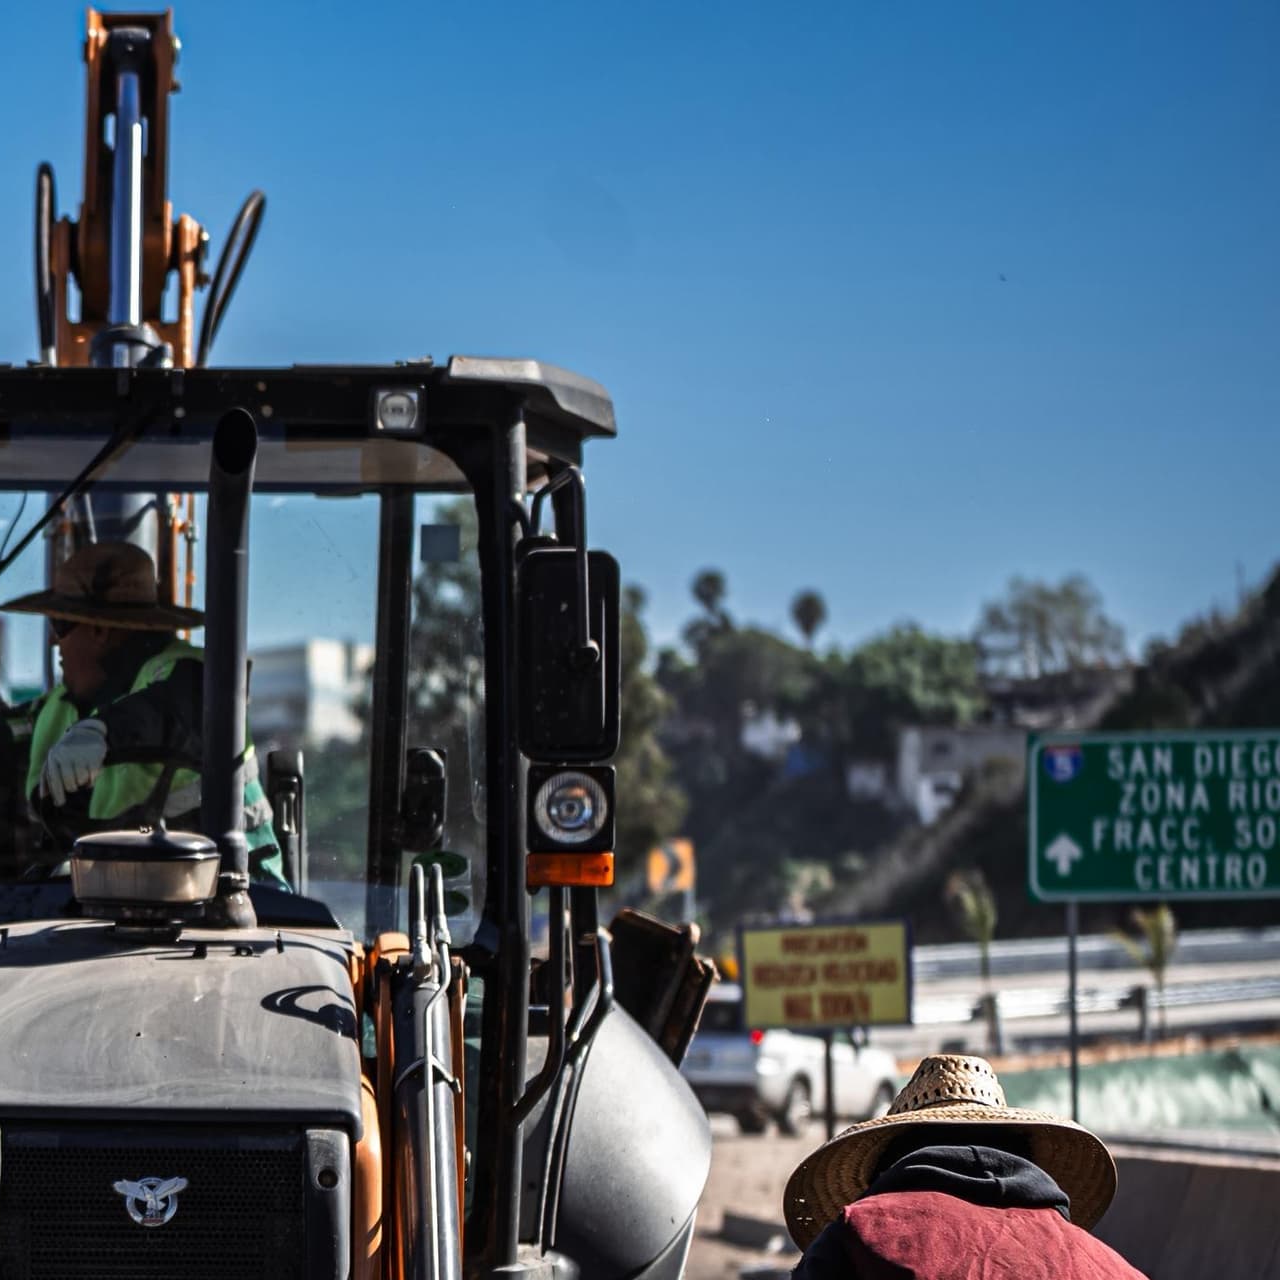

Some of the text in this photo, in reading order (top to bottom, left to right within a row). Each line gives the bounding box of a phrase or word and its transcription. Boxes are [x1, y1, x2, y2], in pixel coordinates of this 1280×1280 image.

[1107, 745, 1173, 780] SAN
[1194, 744, 1280, 778] DIEG
[1119, 779, 1280, 815] ZONA RIO
[1135, 853, 1267, 890] CENTRO
